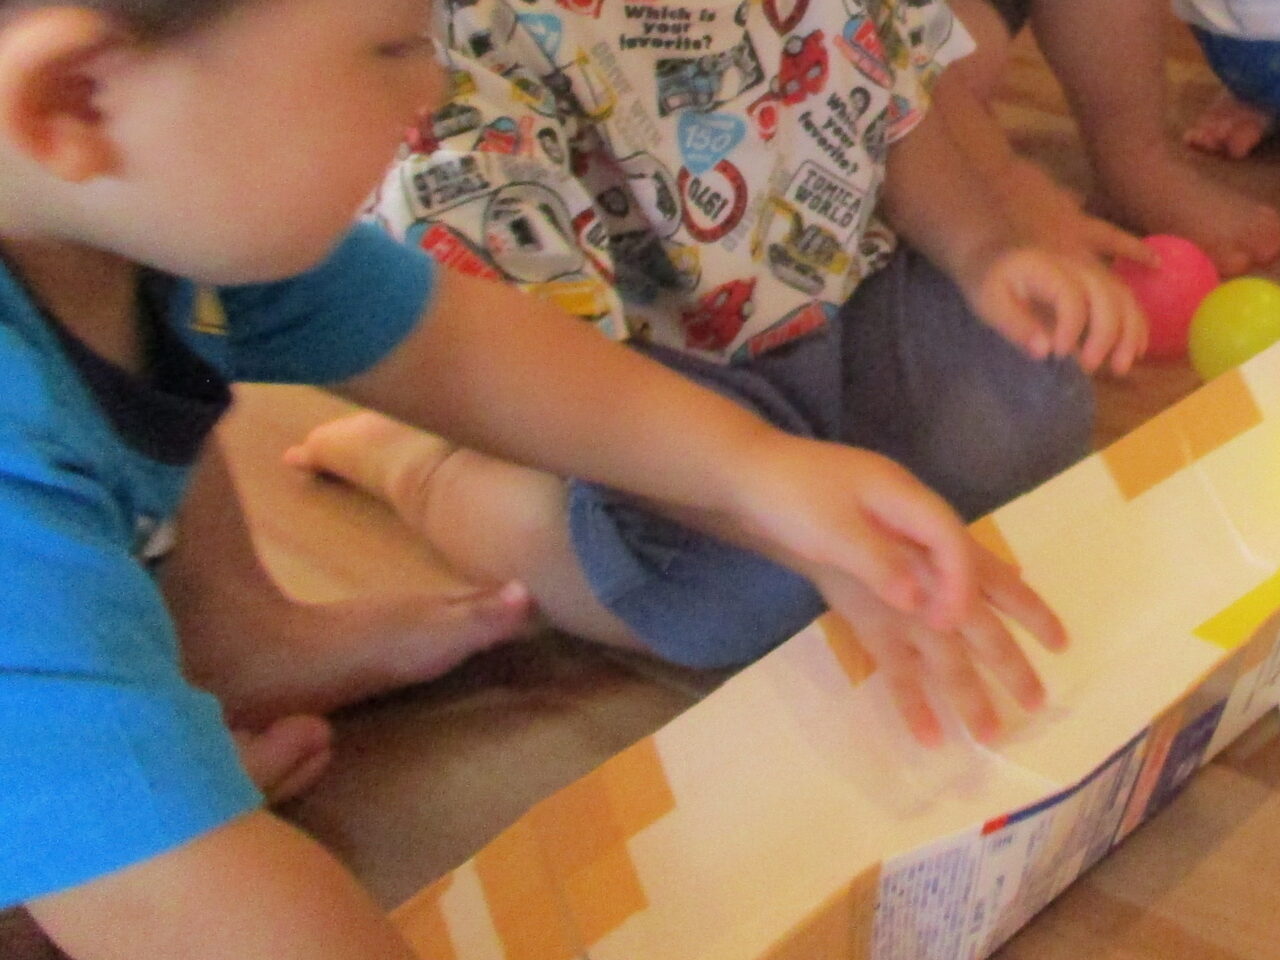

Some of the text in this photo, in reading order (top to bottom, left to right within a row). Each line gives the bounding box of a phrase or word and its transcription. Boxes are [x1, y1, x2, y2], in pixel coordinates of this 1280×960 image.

[624, 4, 716, 22] Which is
[643, 22, 690, 34] your
[619, 33, 713, 51] favorite?
[803, 168, 862, 214] TOMICA
[795, 184, 854, 229] WORLD
